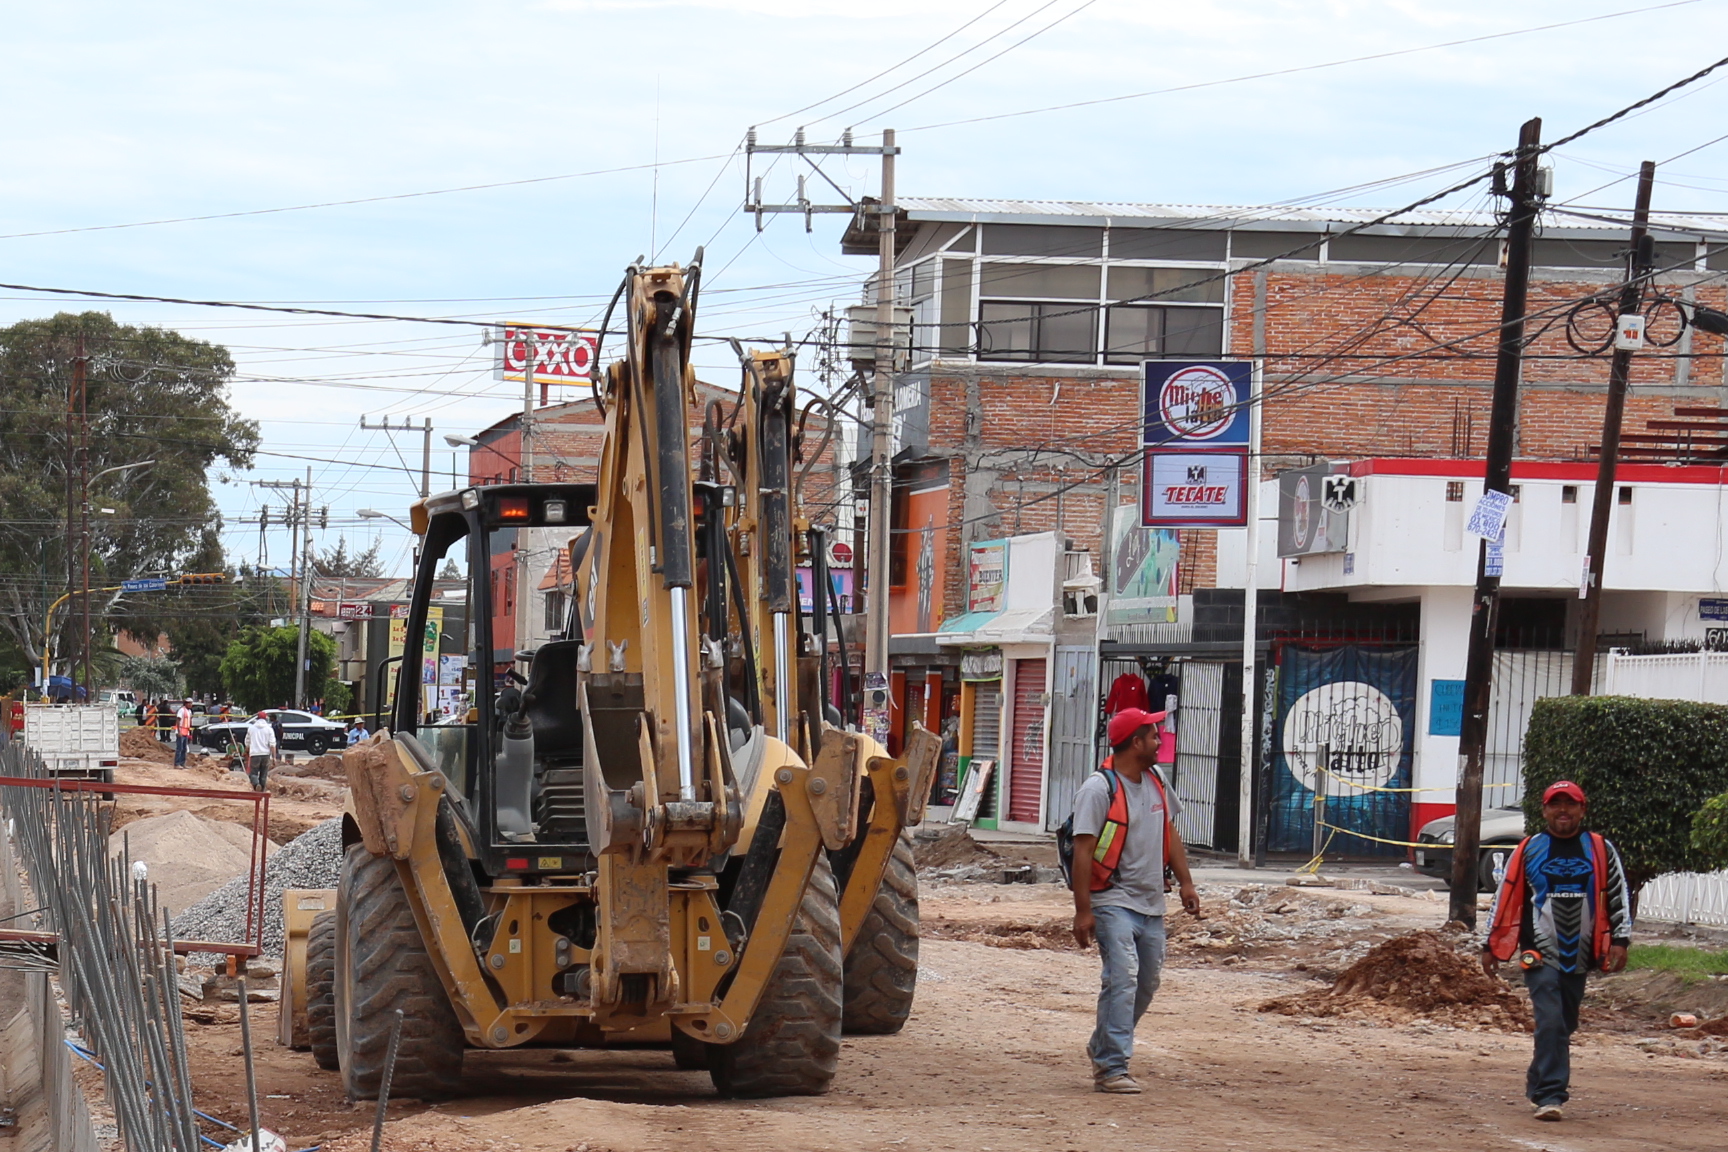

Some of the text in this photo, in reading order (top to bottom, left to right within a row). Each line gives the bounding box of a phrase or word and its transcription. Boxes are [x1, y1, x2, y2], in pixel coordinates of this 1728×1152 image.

[507, 332, 594, 375] OXXO
[1164, 484, 1227, 505] TECATE
[1478, 499, 1505, 512] ACCIONES
[1470, 515, 1481, 525] 01
[1467, 522, 1499, 540] 670-2421
[355, 606, 372, 617] 24
[1700, 605, 1713, 615] PASEO
[1298, 710, 1383, 744] Miche
[1325, 743, 1381, 773] latto
